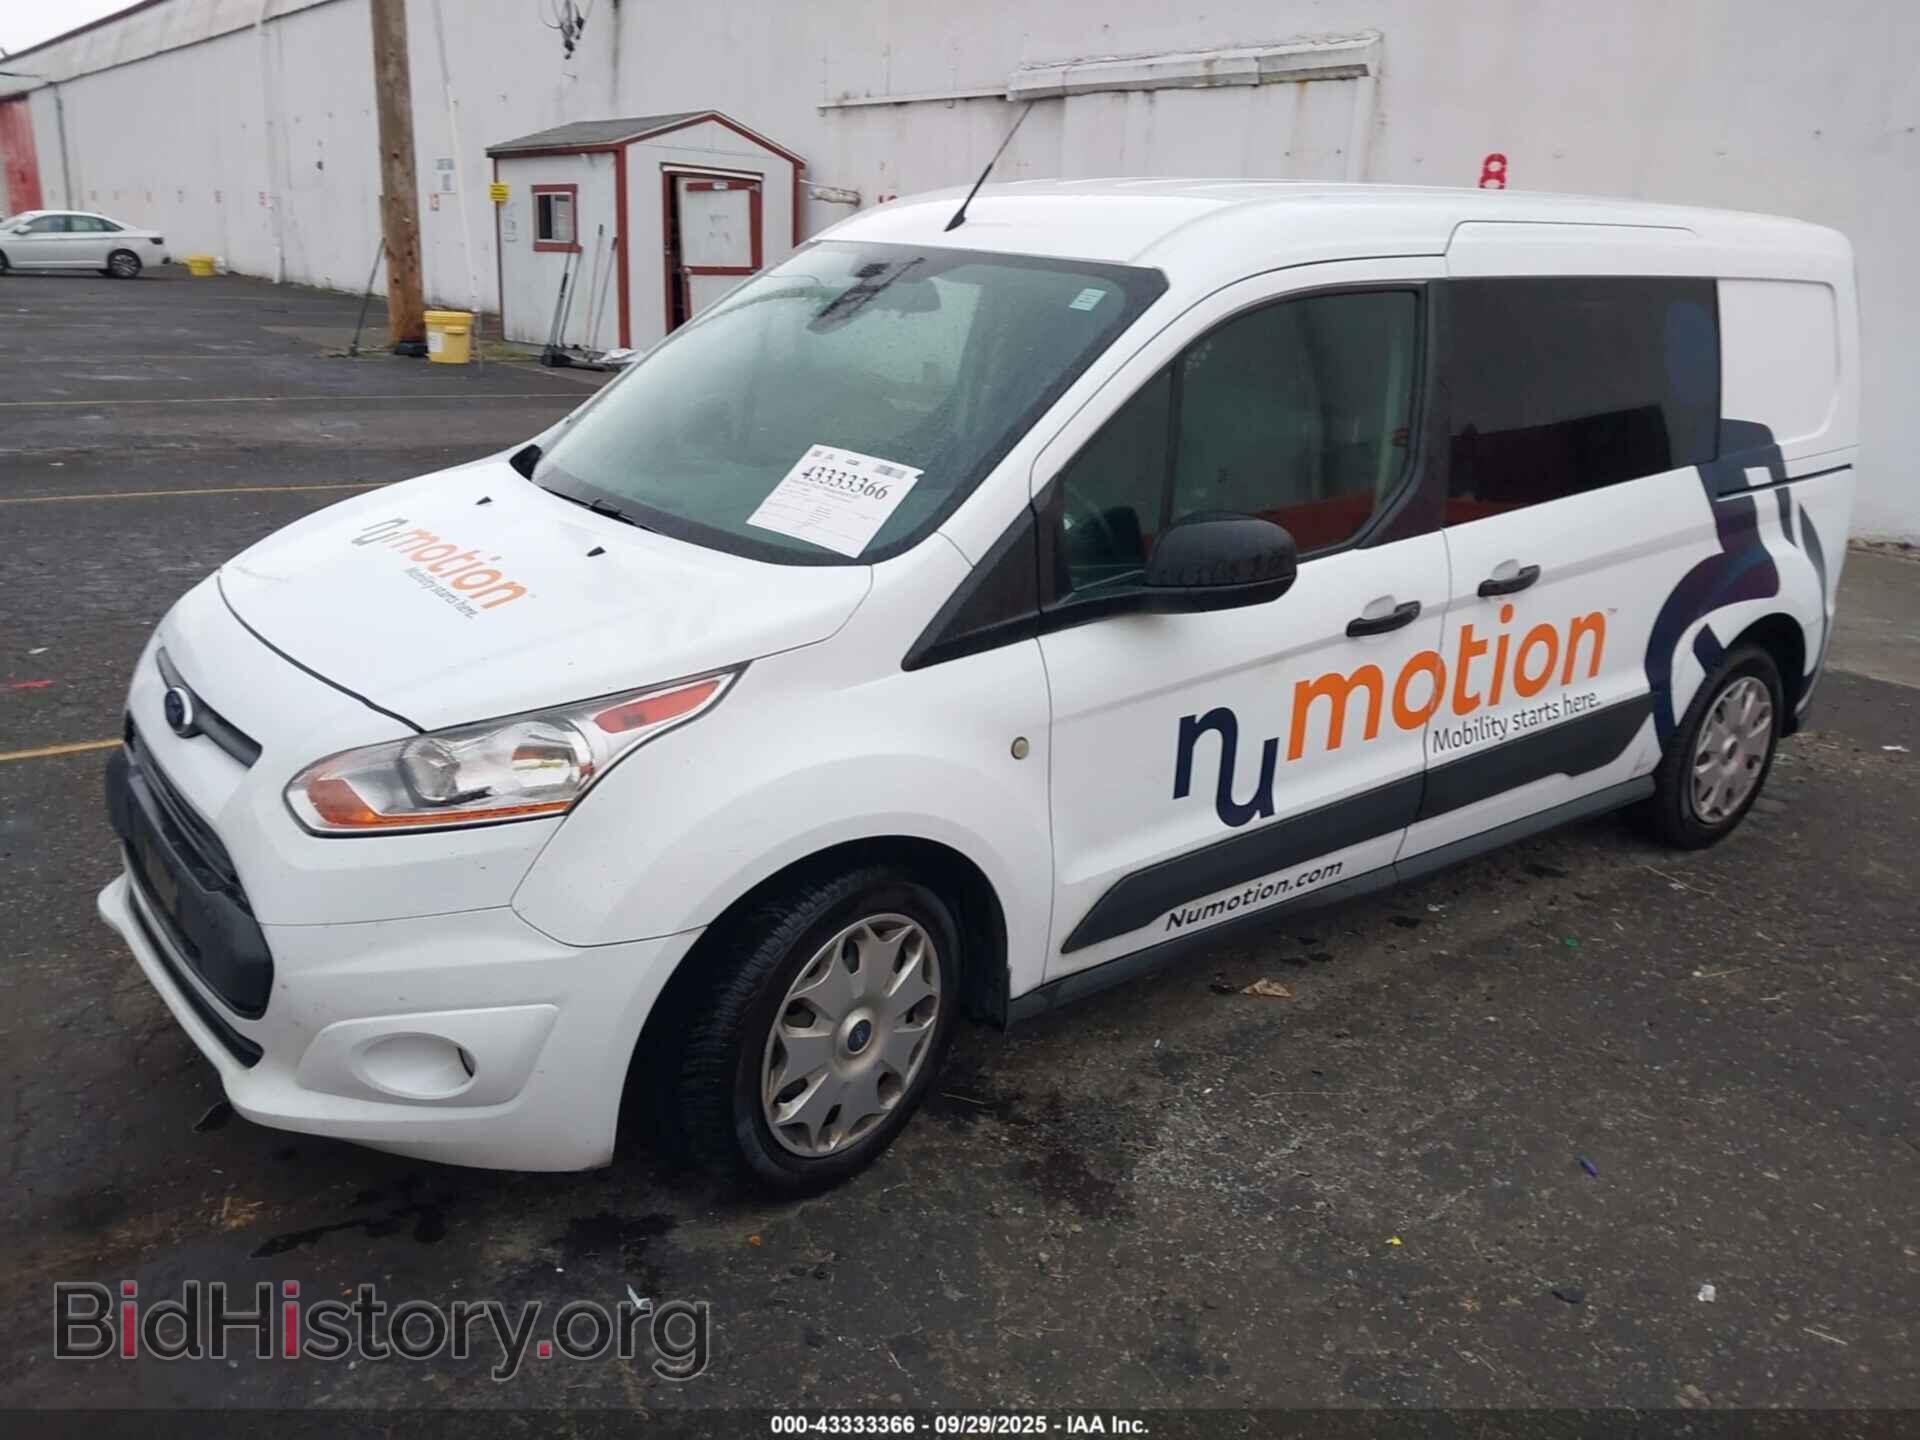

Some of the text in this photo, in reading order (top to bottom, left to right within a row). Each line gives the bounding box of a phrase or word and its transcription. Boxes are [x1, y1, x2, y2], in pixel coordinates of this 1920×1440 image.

[801, 464, 892, 501] 43333366
[1432, 691, 1602, 753] Mobility starts here.
[1165, 861, 1344, 932] Numotion.com
